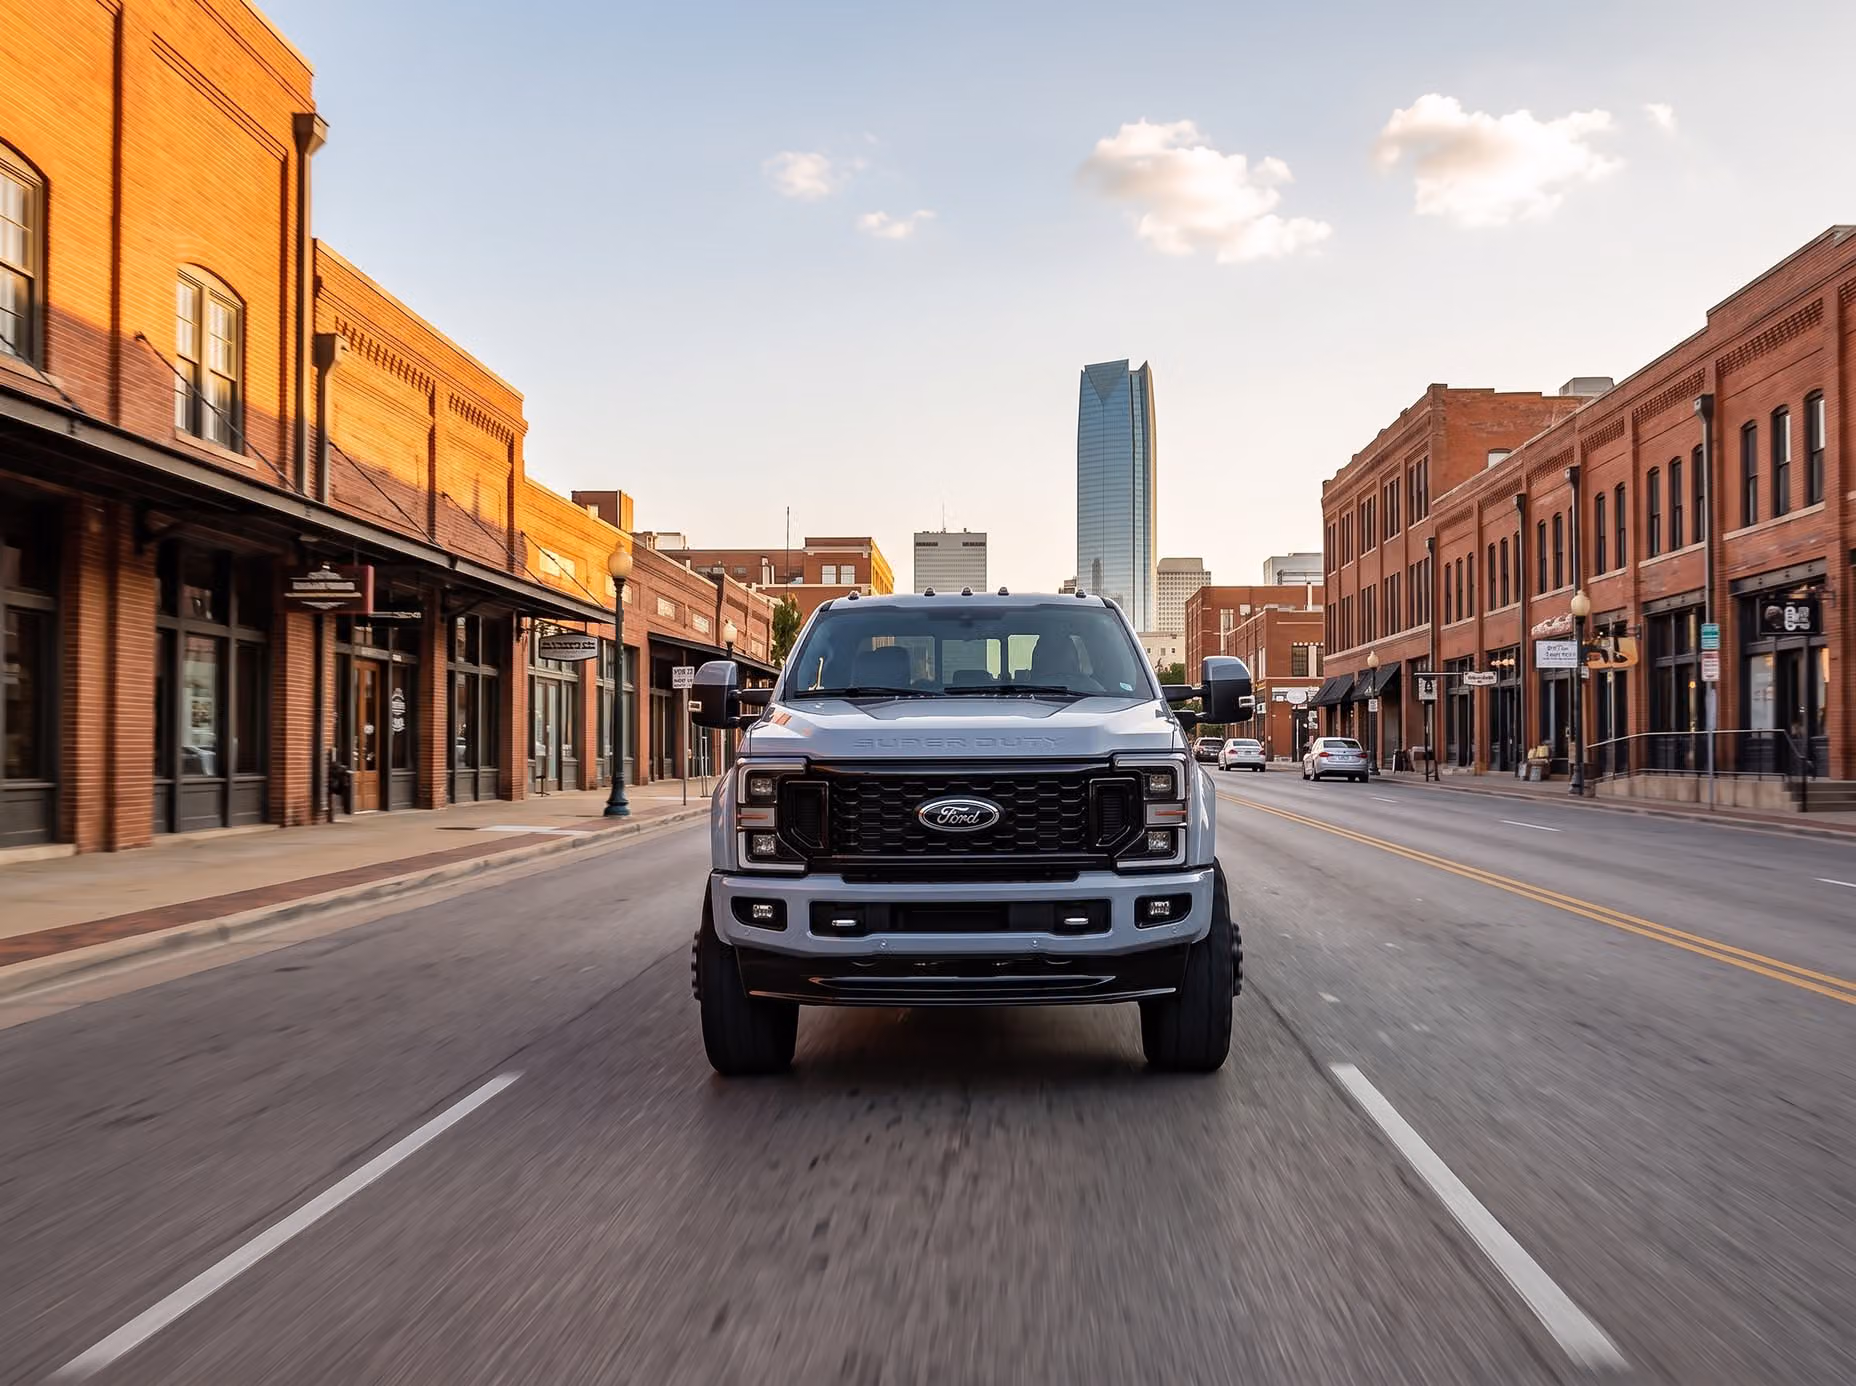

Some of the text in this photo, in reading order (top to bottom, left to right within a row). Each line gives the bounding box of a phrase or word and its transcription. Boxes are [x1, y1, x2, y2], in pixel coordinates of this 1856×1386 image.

[853, 737, 1064, 748] SUPER DUTY
[937, 806, 980, 824] Ford
